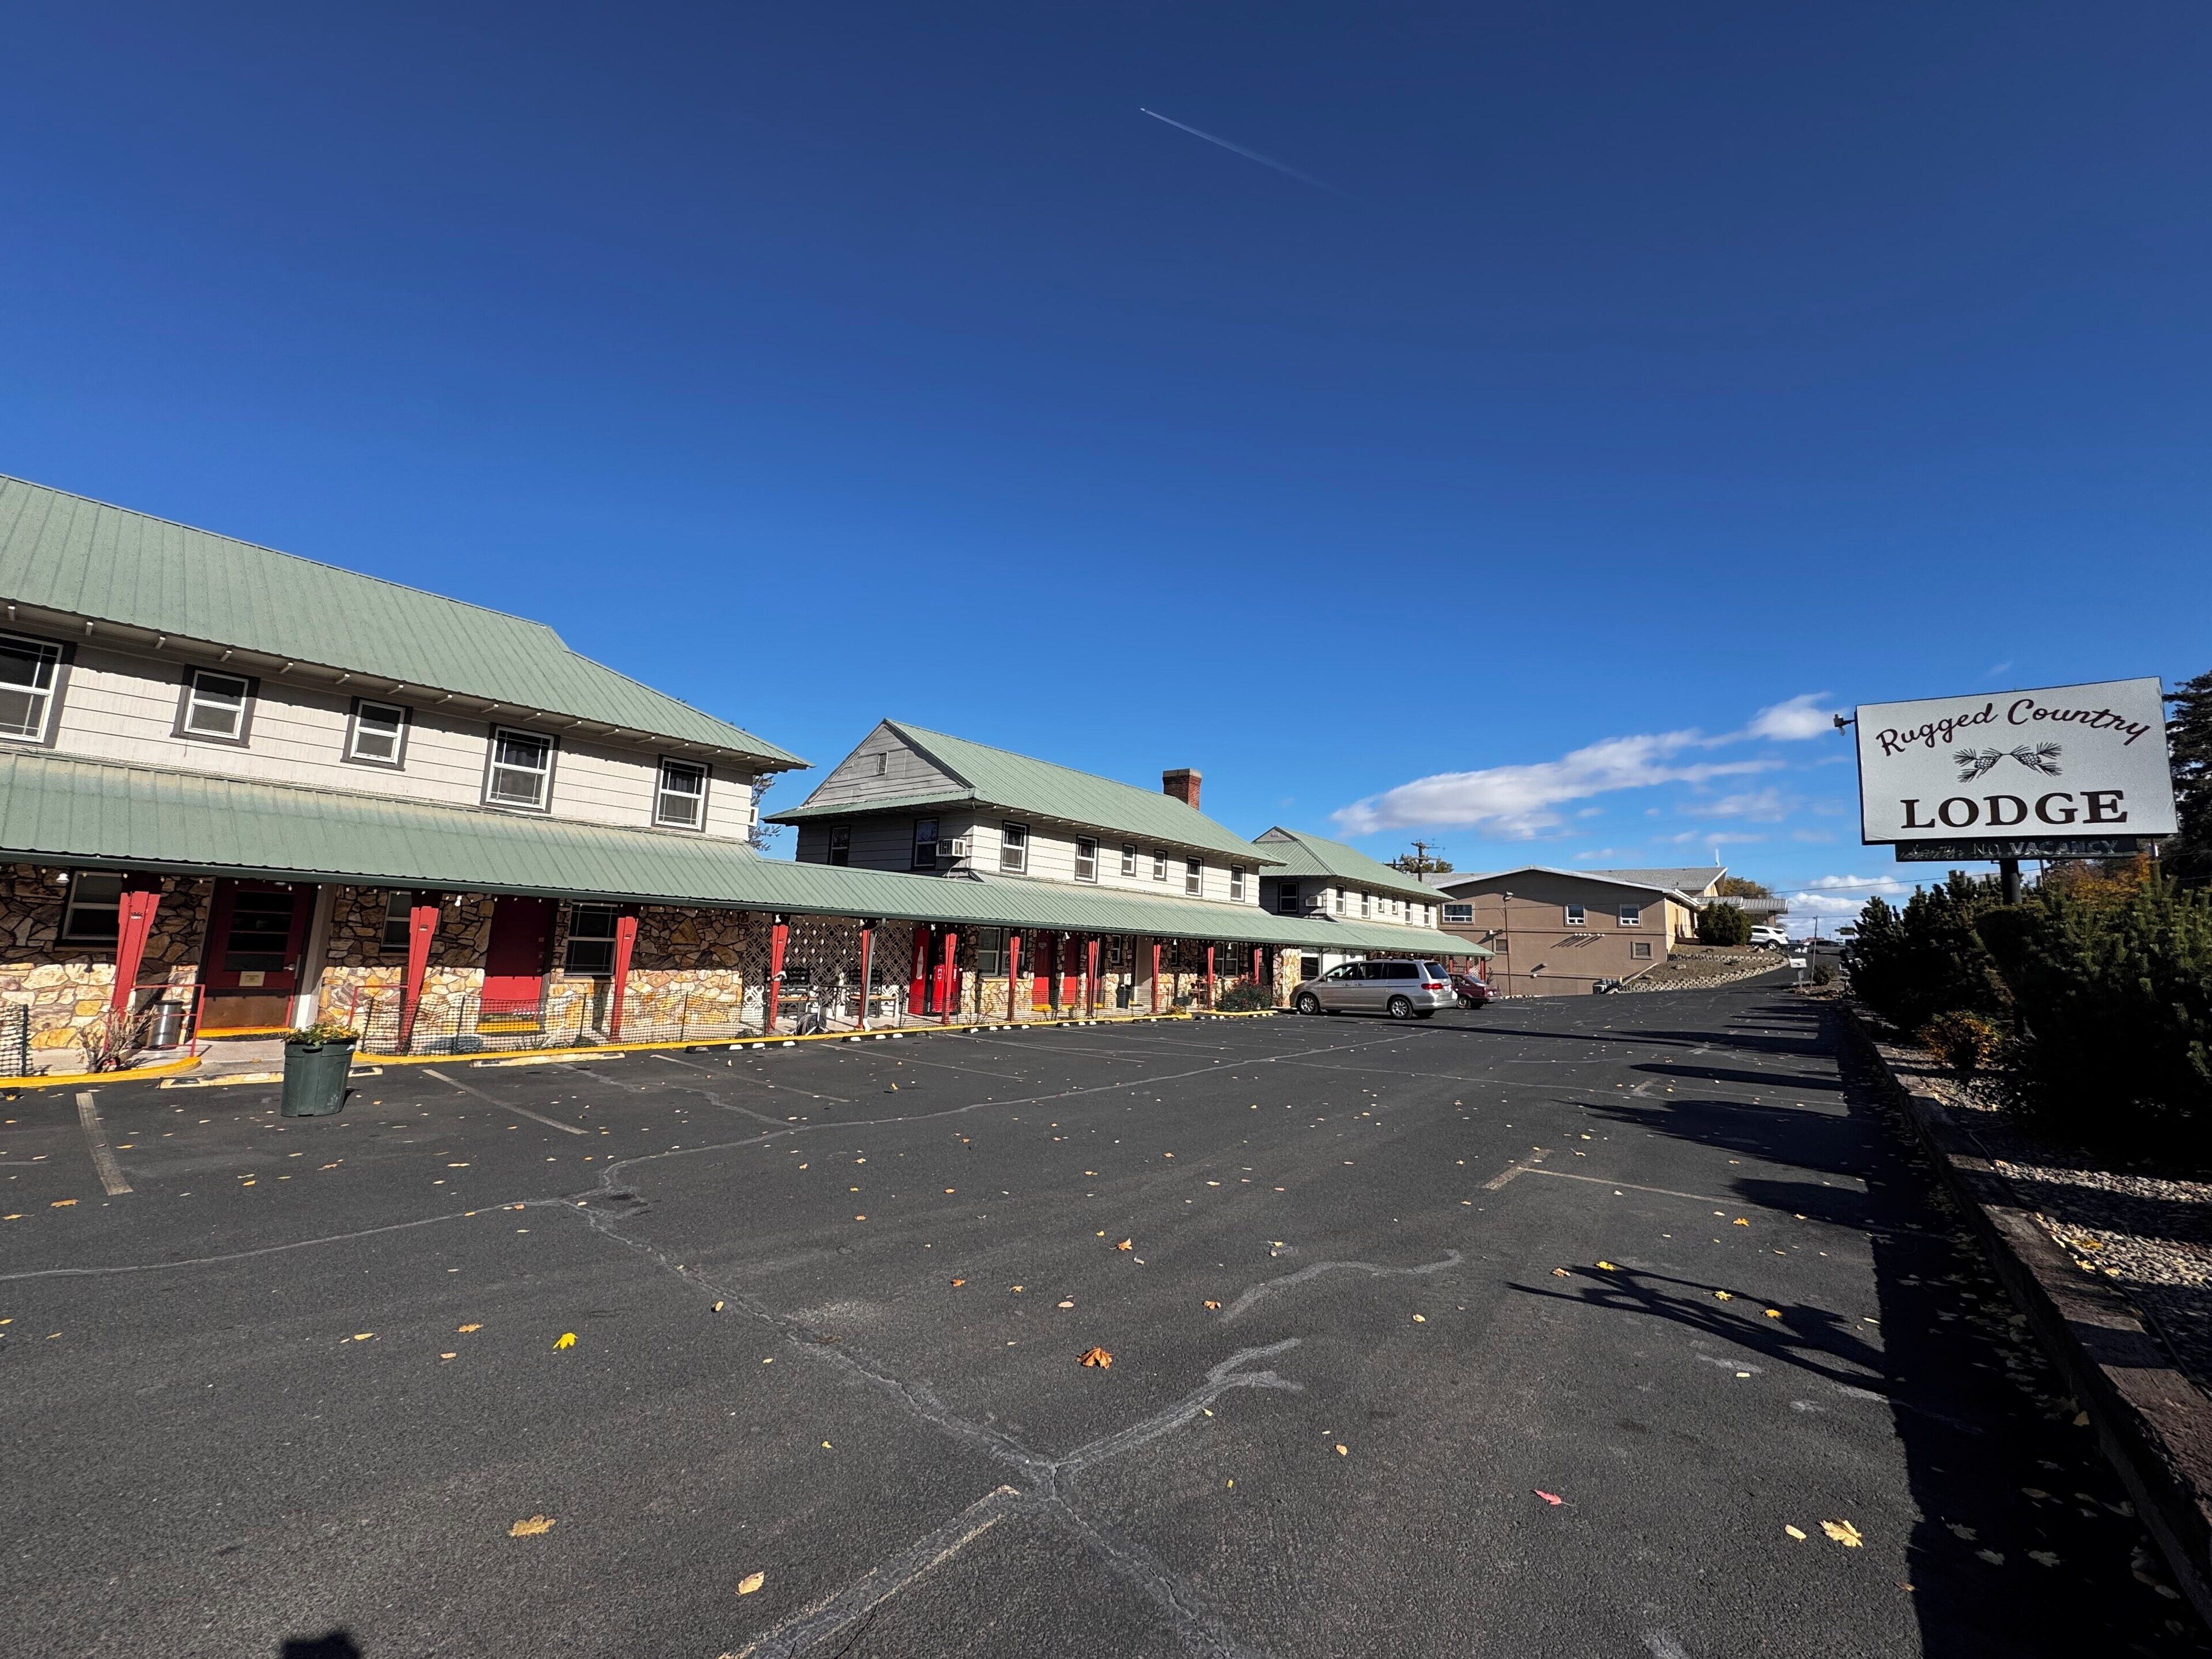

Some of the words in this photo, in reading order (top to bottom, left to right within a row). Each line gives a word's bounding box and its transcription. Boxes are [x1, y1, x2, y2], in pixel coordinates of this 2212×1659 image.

[1876, 703, 1998, 756] Rugged
[2008, 699, 2151, 745] Country
[1900, 790, 2128, 829] LODGE
[1973, 843, 2000, 855] NO
[2009, 840, 2118, 855] VACANCY
